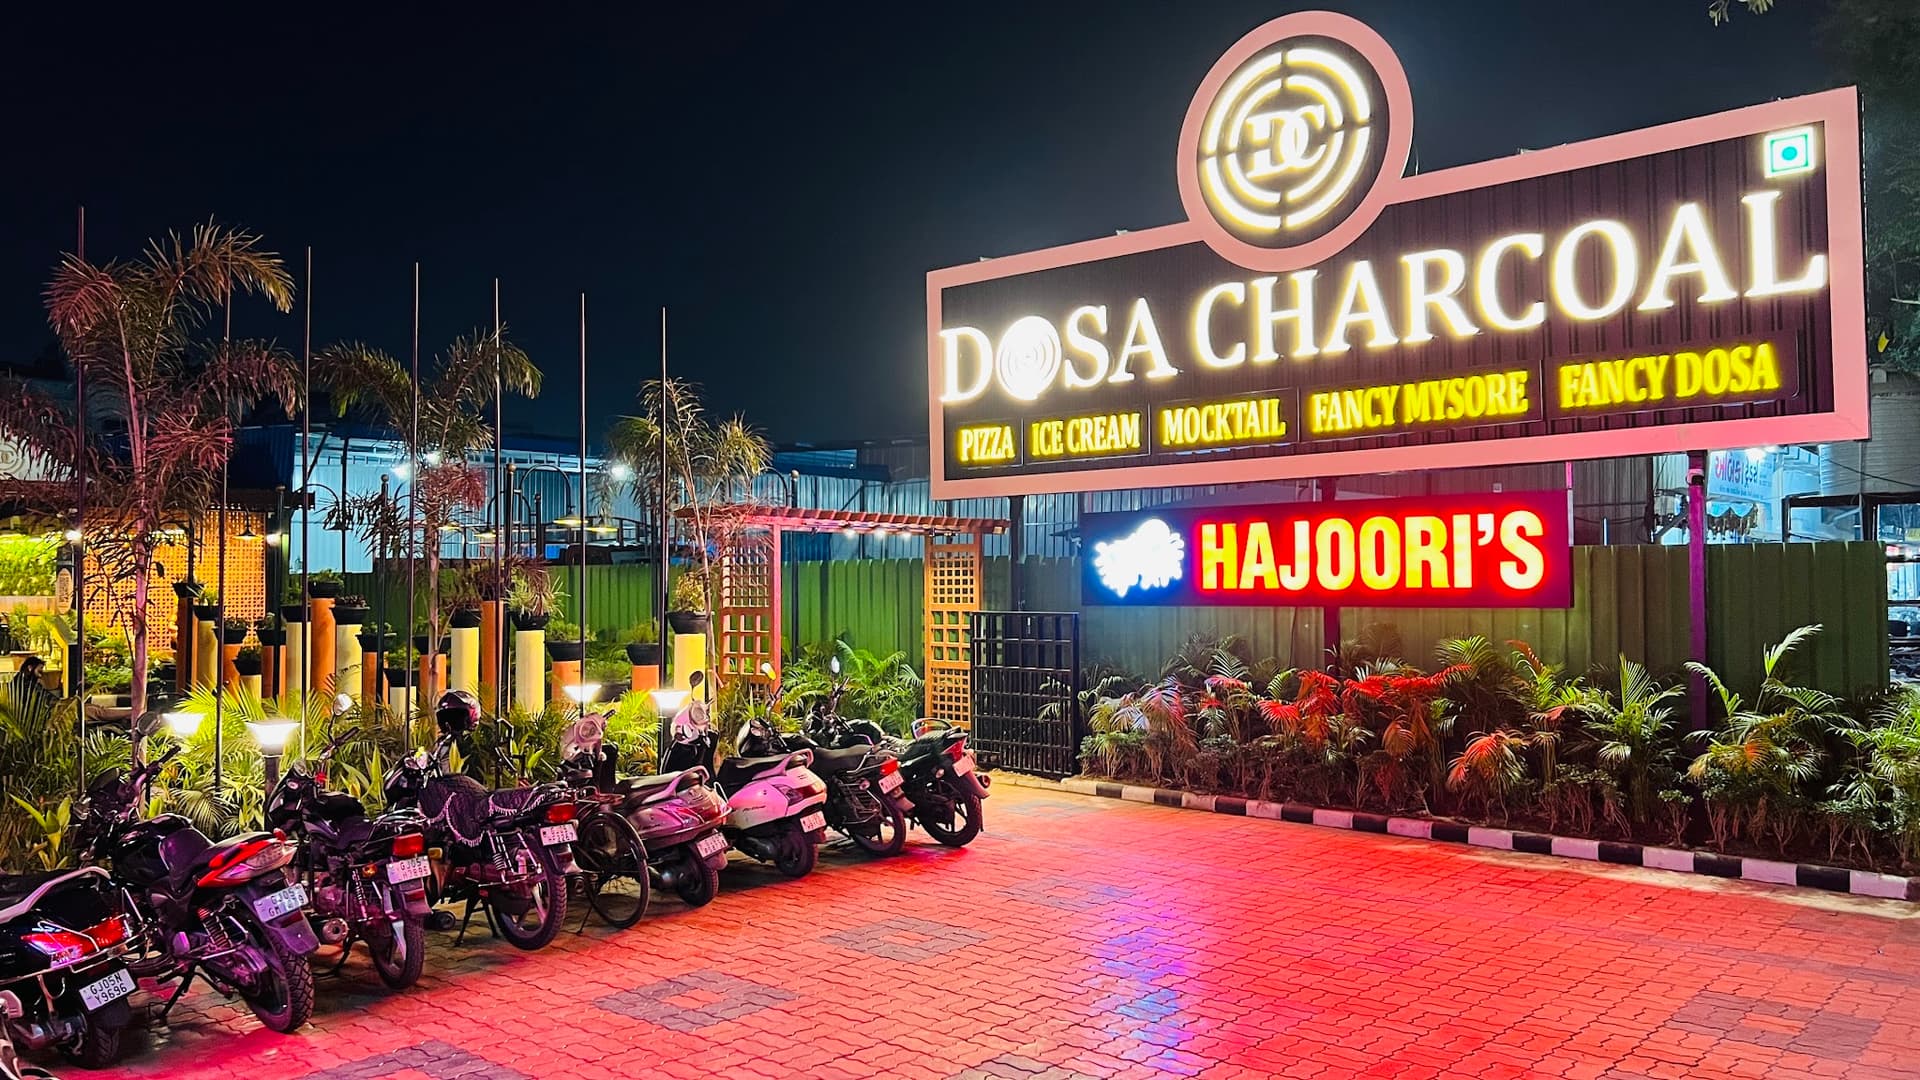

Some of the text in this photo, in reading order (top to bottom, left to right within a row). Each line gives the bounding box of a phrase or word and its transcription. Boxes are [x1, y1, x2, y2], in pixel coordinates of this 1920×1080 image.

[940, 189, 1827, 403] DOSA CHARCOAL
[1560, 344, 1779, 410] FANCY DOSA
[1163, 398, 1286, 446] MOCKTAIL
[1312, 370, 1529, 434] FANCY MYSORE
[960, 426, 1015, 463] PIZZA
[1032, 413, 1140, 456] ICE CREAM
[1201, 510, 1544, 591] HAJOORI’S
[271, 887, 296, 905] GJ05
[90, 972, 122, 995] GJ05N
[95, 983, 128, 1005] Y9696
